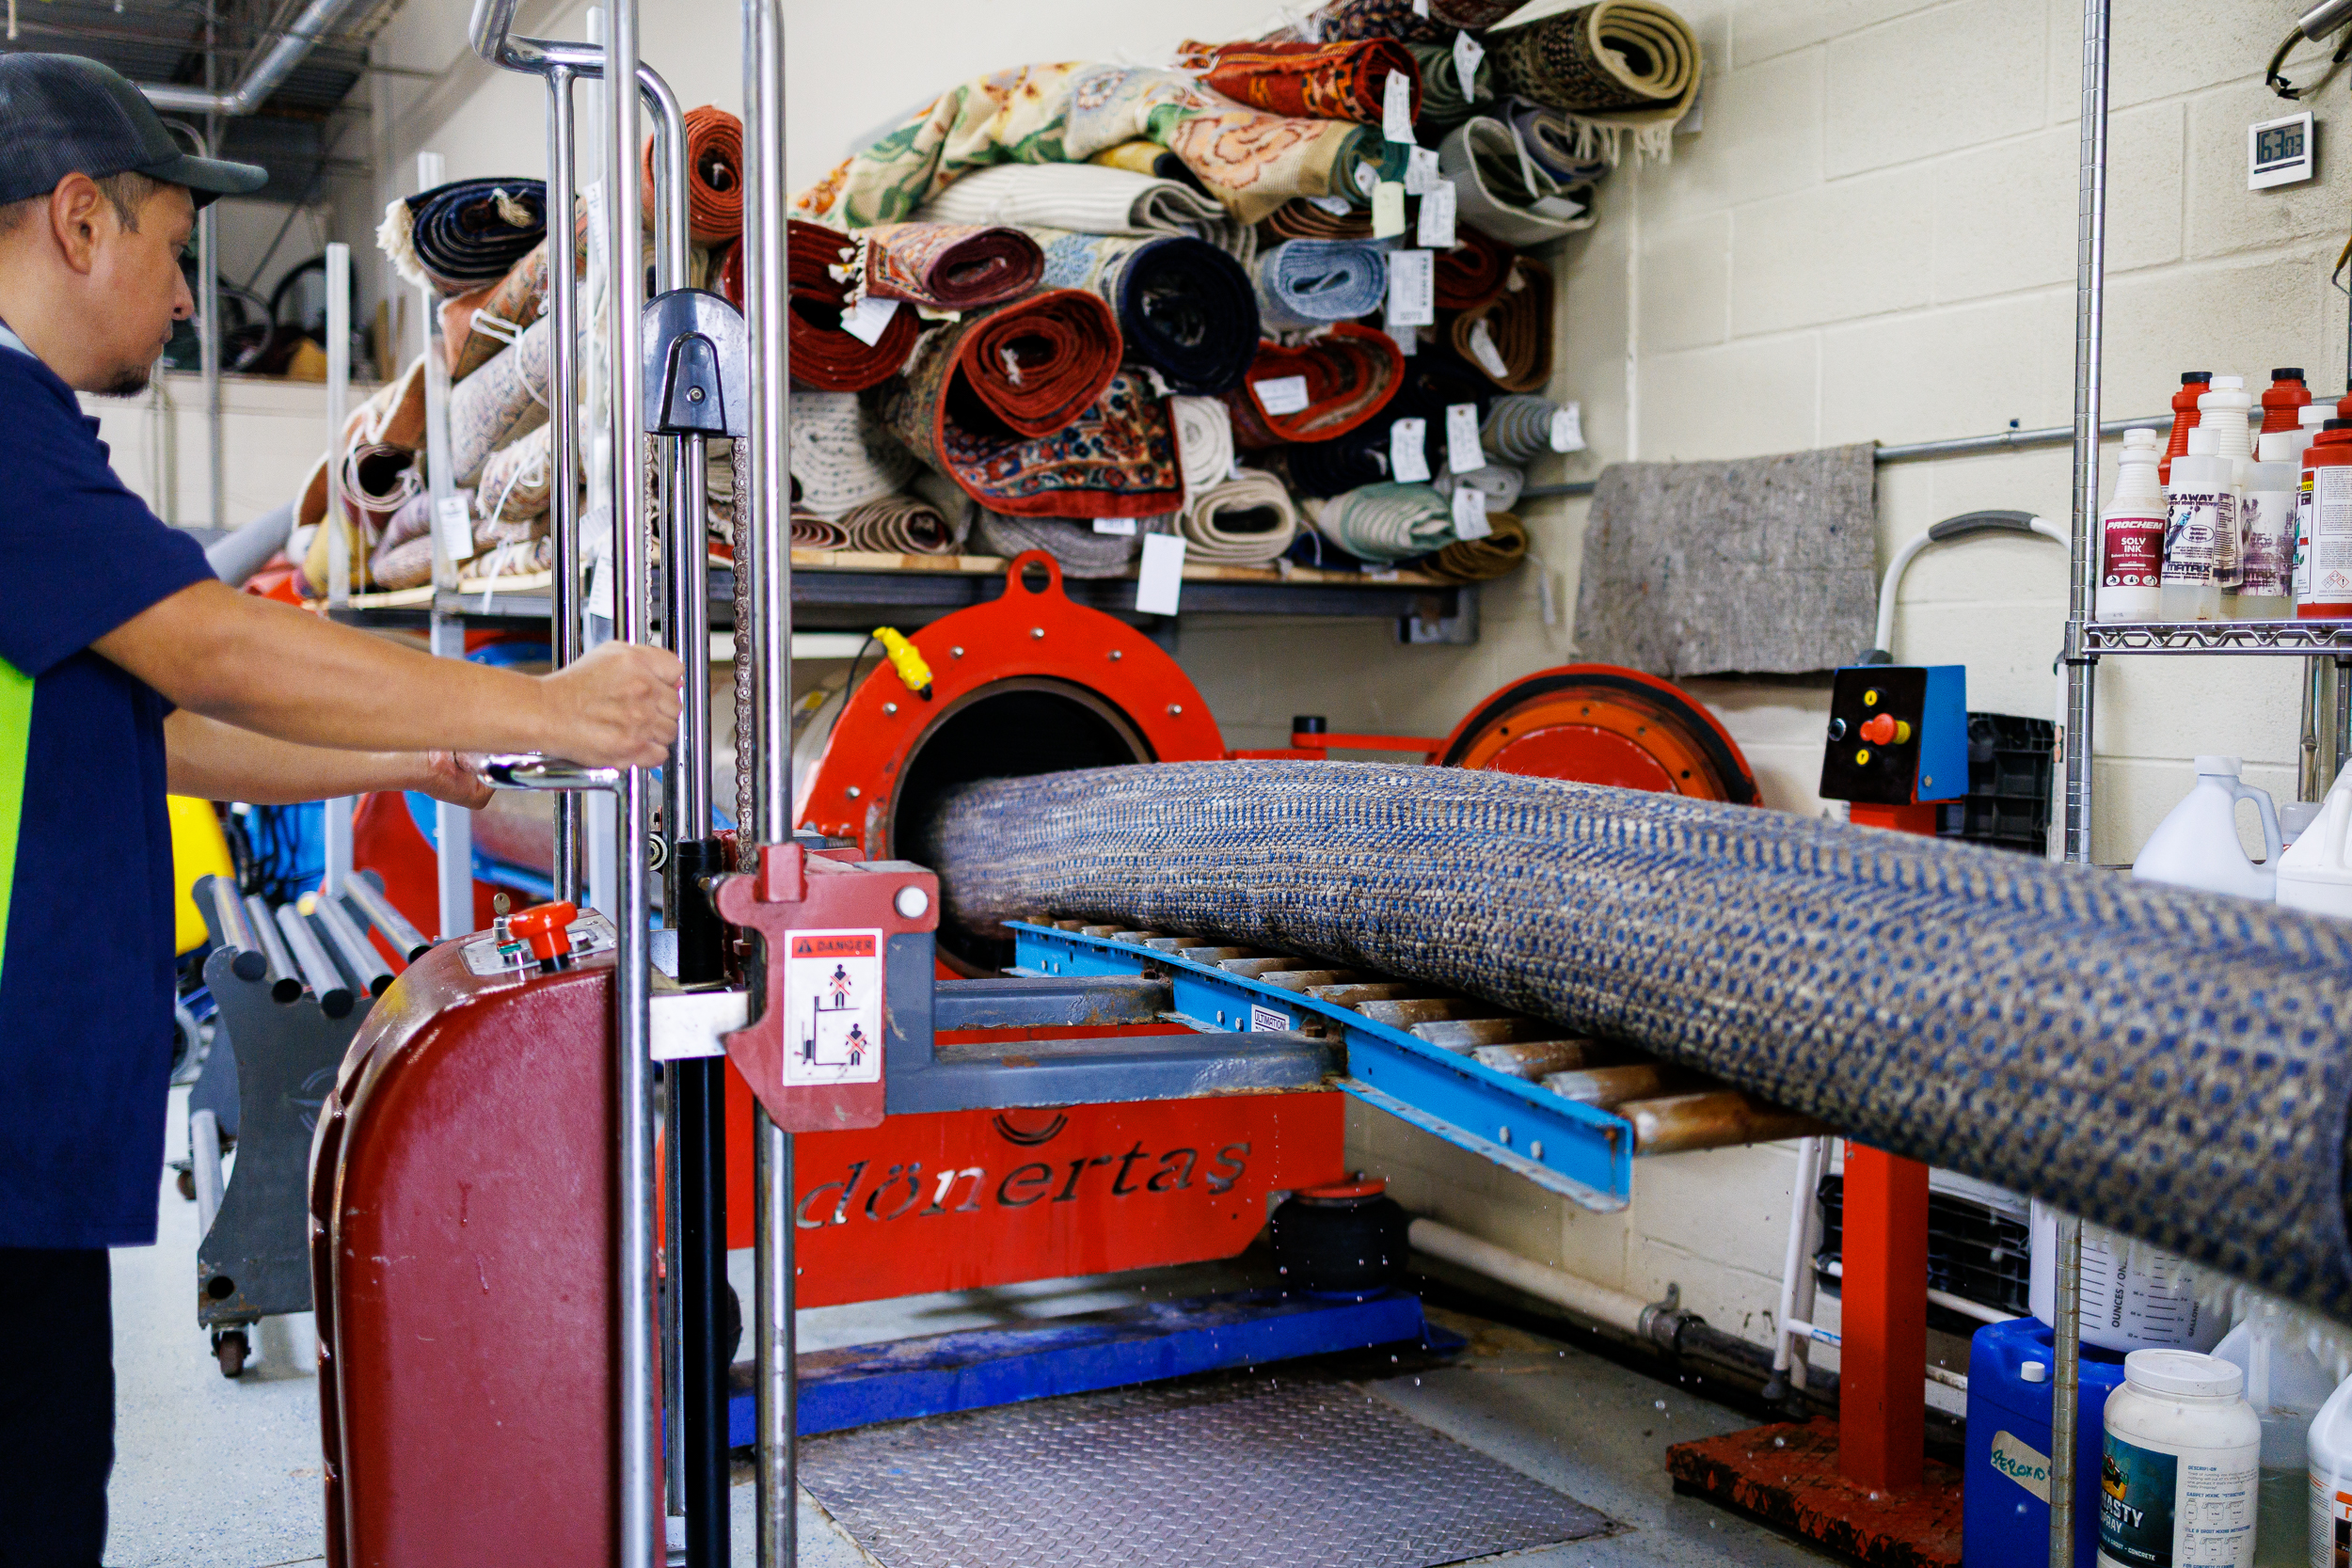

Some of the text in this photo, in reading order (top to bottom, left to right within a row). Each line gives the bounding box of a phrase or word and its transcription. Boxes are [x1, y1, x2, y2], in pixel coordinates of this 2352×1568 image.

[2180, 493, 2215, 501] AWAY
[2106, 520, 2164, 531] PROCHEM
[2121, 537, 2147, 546] SOLV
[2123, 545, 2142, 553] INK
[816, 940, 874, 952] DANGER
[1255, 1011, 1285, 1030] ULTIMATION
[795, 1139, 1253, 1229] dönertaş
[2117, 1258, 2128, 1280] ON
[2111, 1289, 2124, 1328] OUNCES
[2110, 1539, 2124, 1550] GROUT
[2127, 1547, 2156, 1561] CONCRETE
